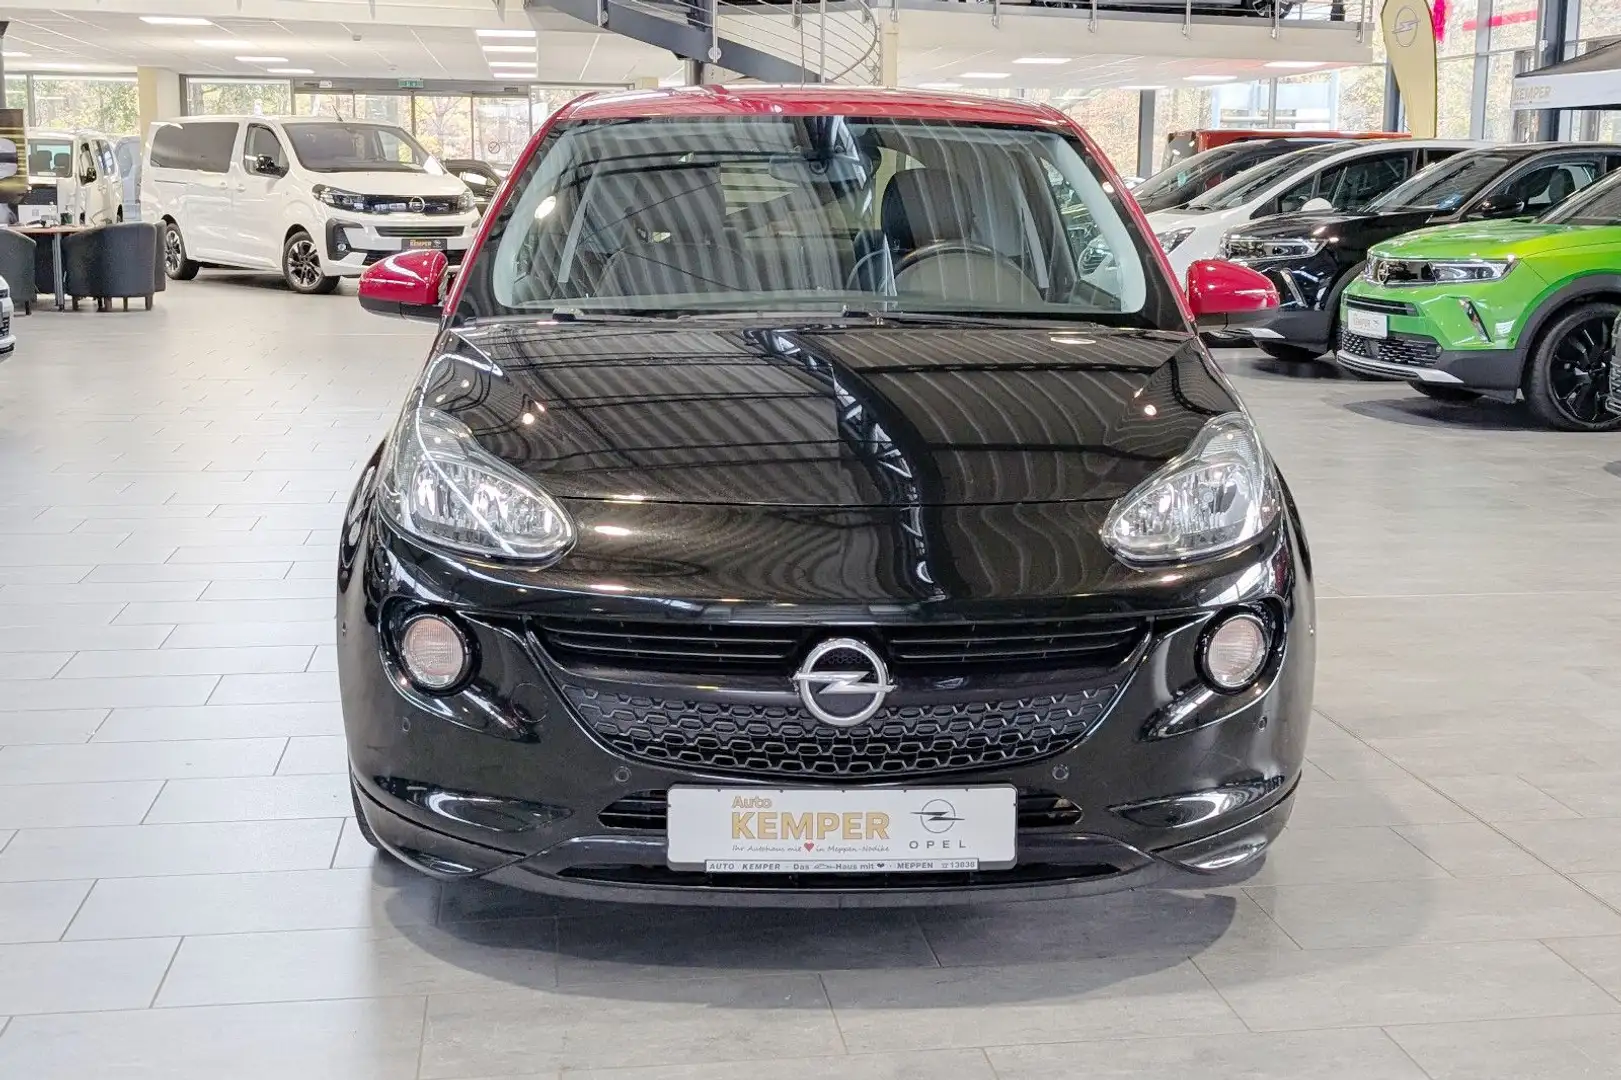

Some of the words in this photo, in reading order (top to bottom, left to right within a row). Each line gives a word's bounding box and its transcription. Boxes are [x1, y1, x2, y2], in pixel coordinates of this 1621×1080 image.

[732, 796, 772, 808] Auto
[731, 812, 890, 840] KEMPER
[909, 839, 966, 849] OPEL
[742, 863, 781, 871] KEMPER
